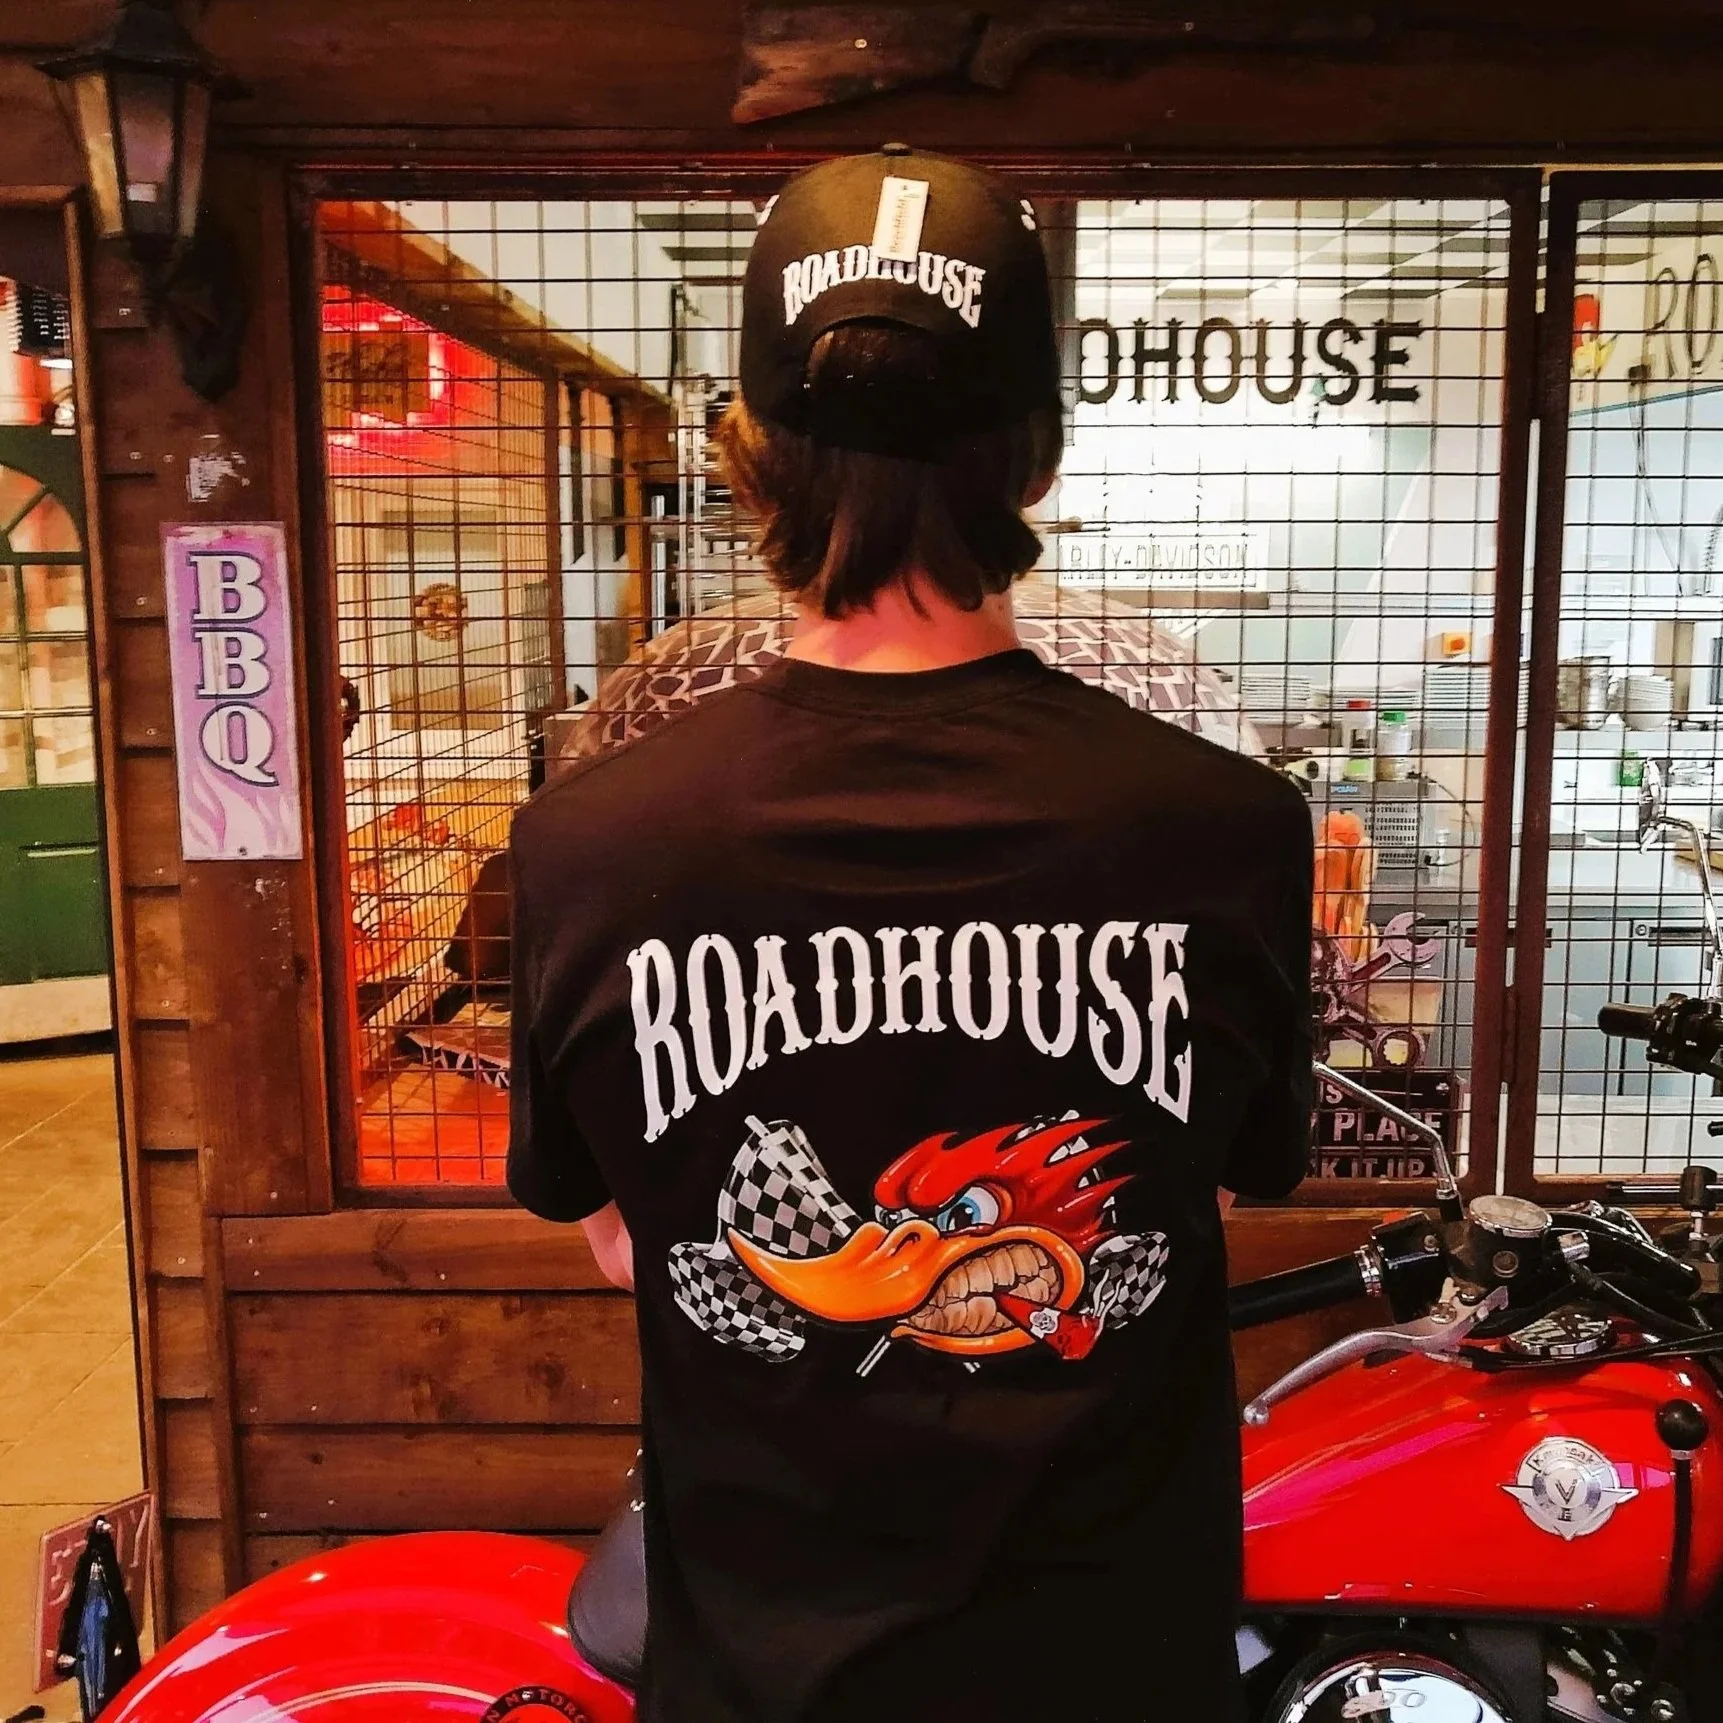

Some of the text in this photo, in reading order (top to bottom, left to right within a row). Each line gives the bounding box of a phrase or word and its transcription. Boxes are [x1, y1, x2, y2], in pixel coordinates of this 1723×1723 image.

[782, 244, 986, 329] ROADHOUSE
[186, 551, 279, 787] BBQ
[625, 920, 1192, 1143] ROADHOUSE
[504, 1688, 587, 1723] MTORC
